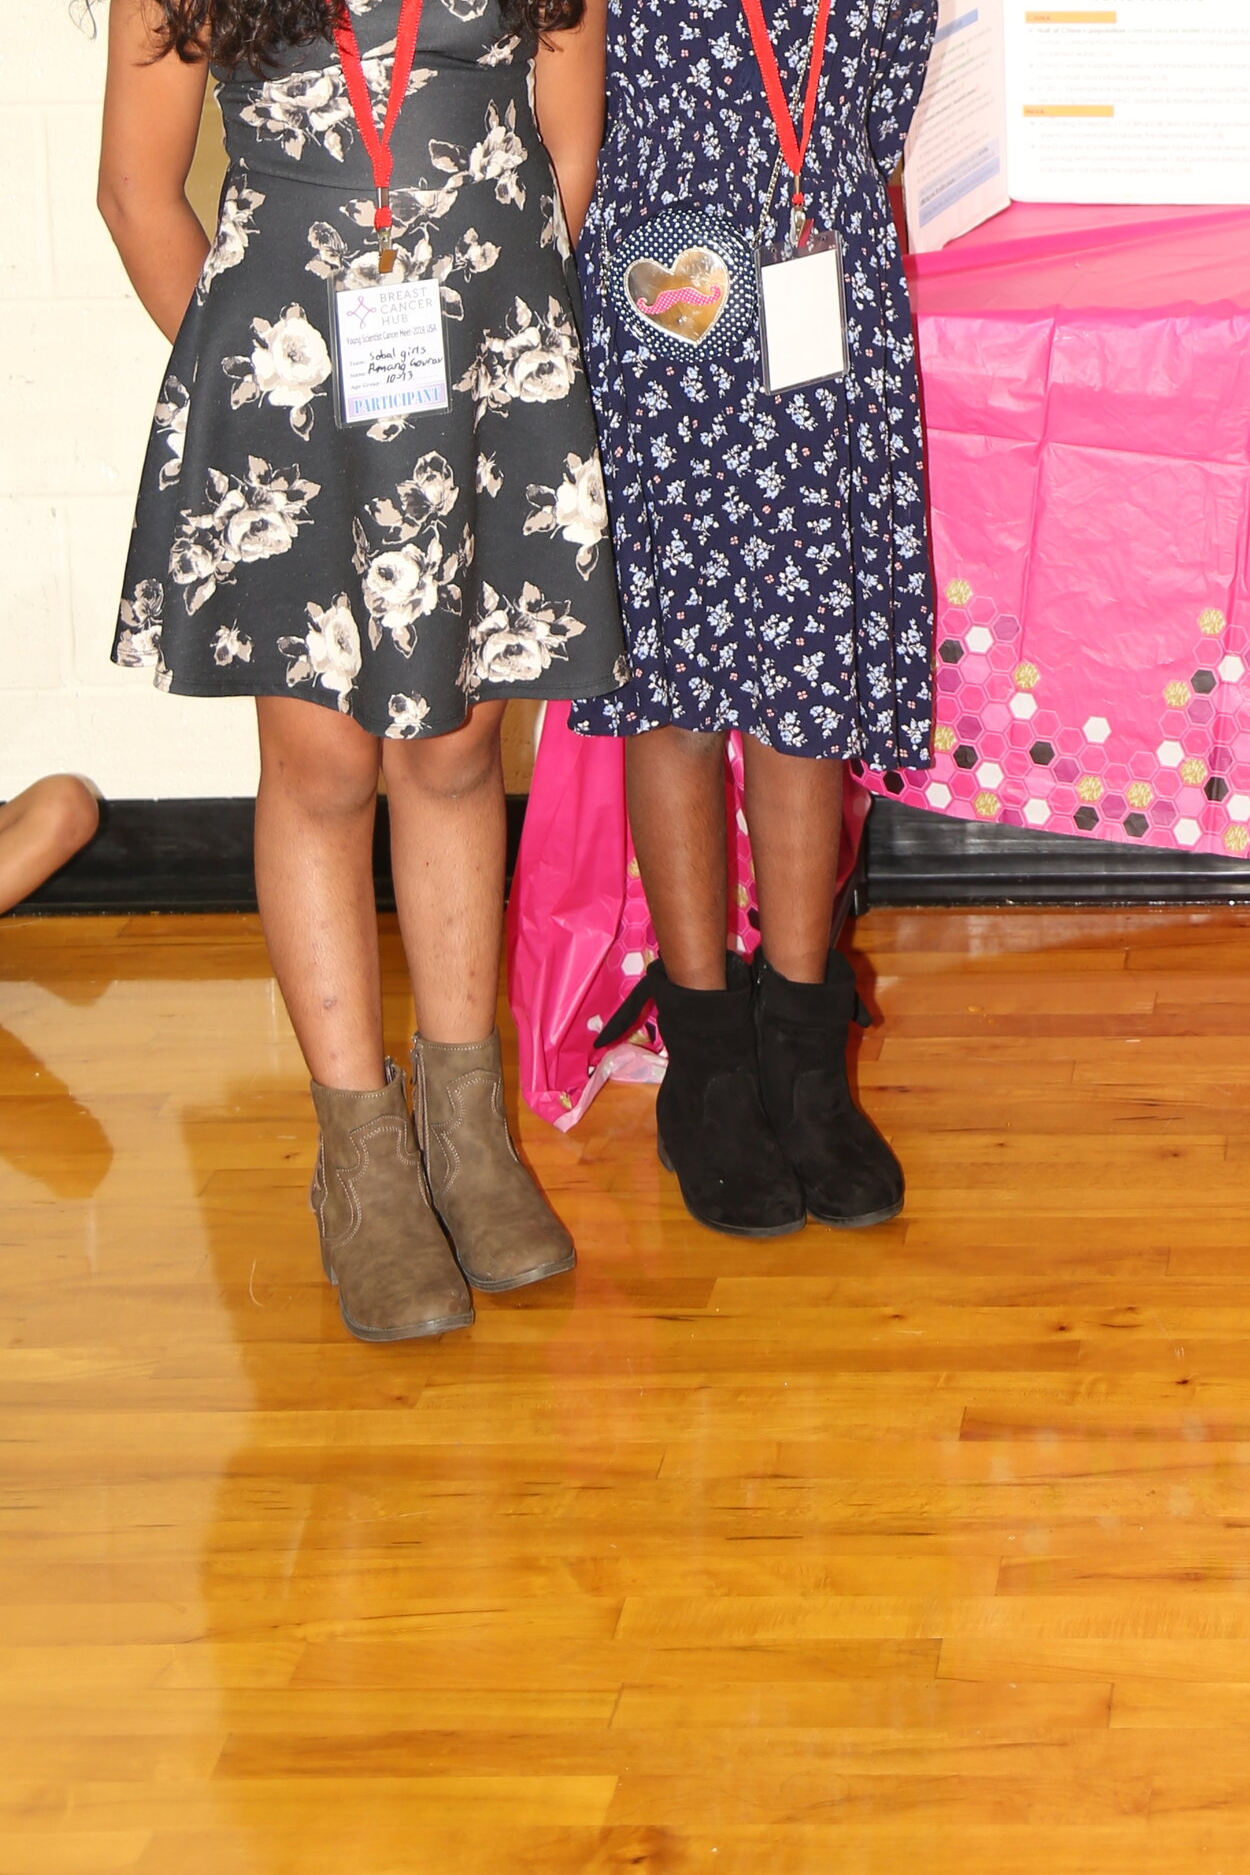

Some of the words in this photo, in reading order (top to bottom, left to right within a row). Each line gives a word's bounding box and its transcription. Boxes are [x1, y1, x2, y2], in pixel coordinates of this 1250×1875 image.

[380, 287, 428, 303] BREAST
[380, 298, 433, 315] CANCER
[381, 314, 409, 326] HUB
[353, 386, 442, 414] PARTICIPANT
